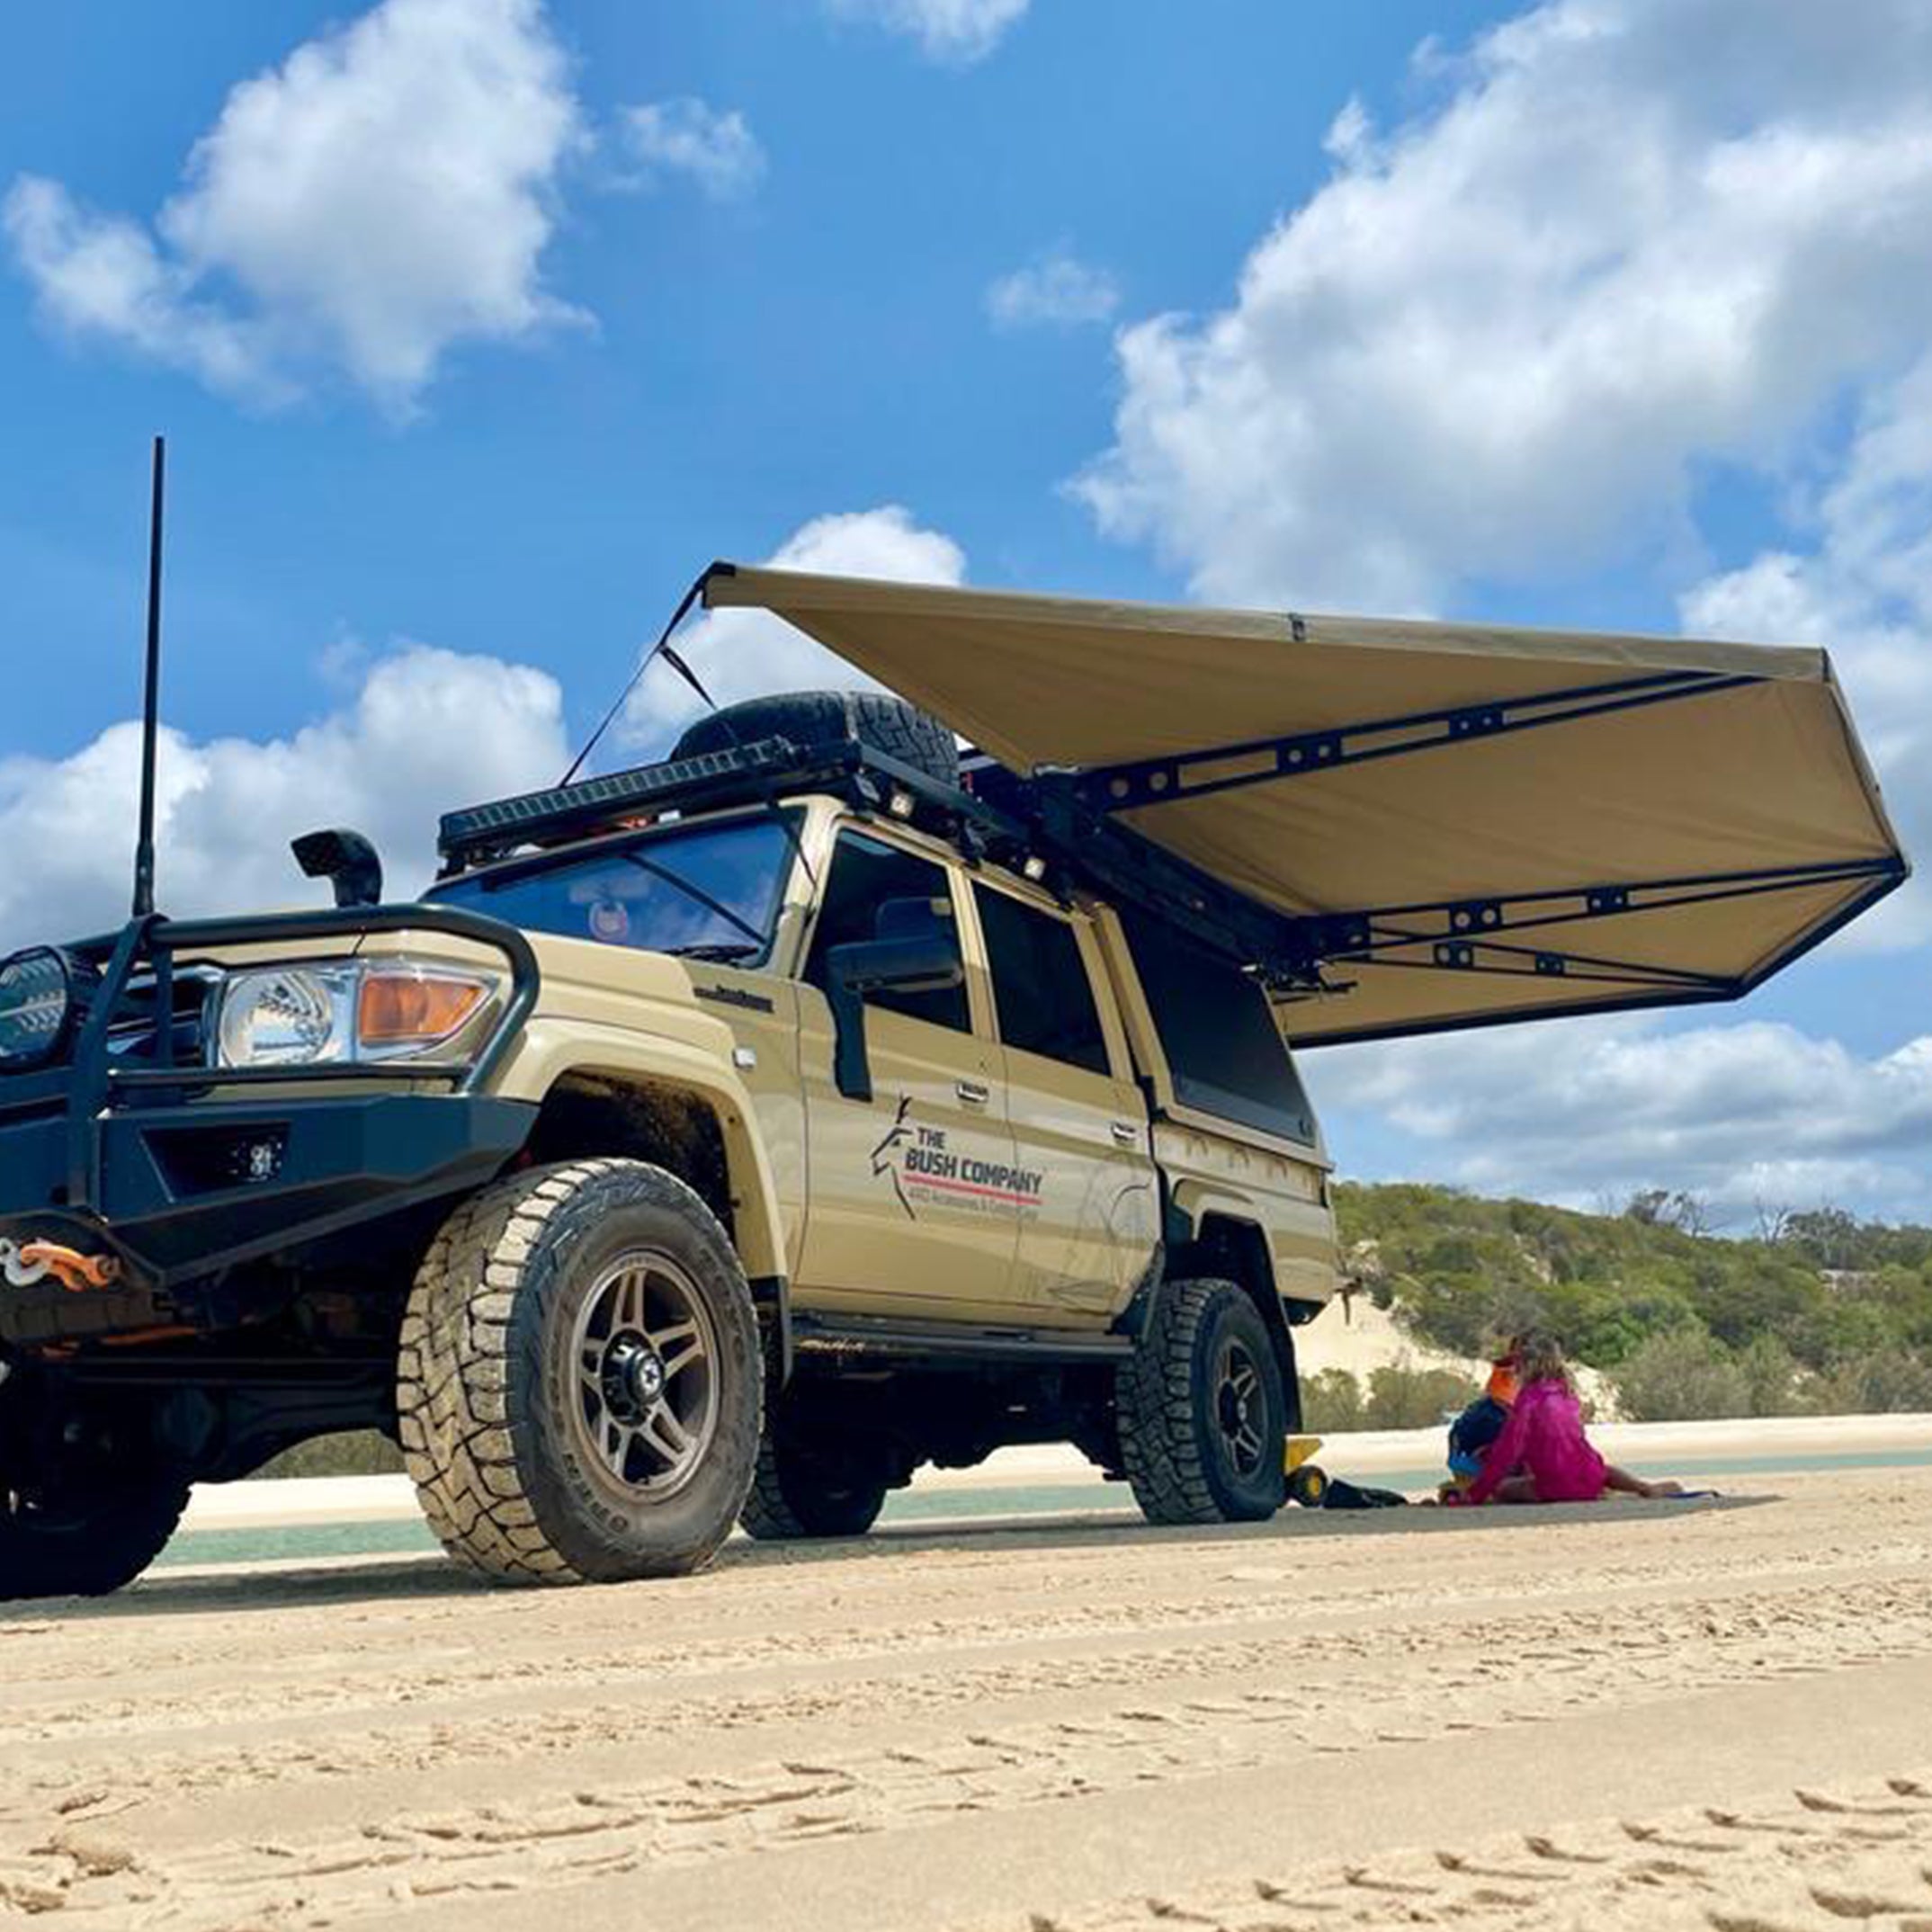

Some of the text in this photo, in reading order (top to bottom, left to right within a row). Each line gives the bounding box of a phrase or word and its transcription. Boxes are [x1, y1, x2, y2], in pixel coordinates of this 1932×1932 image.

[917, 1127, 945, 1149] THE
[905, 1148, 1042, 1194] BUSH COMPANY
